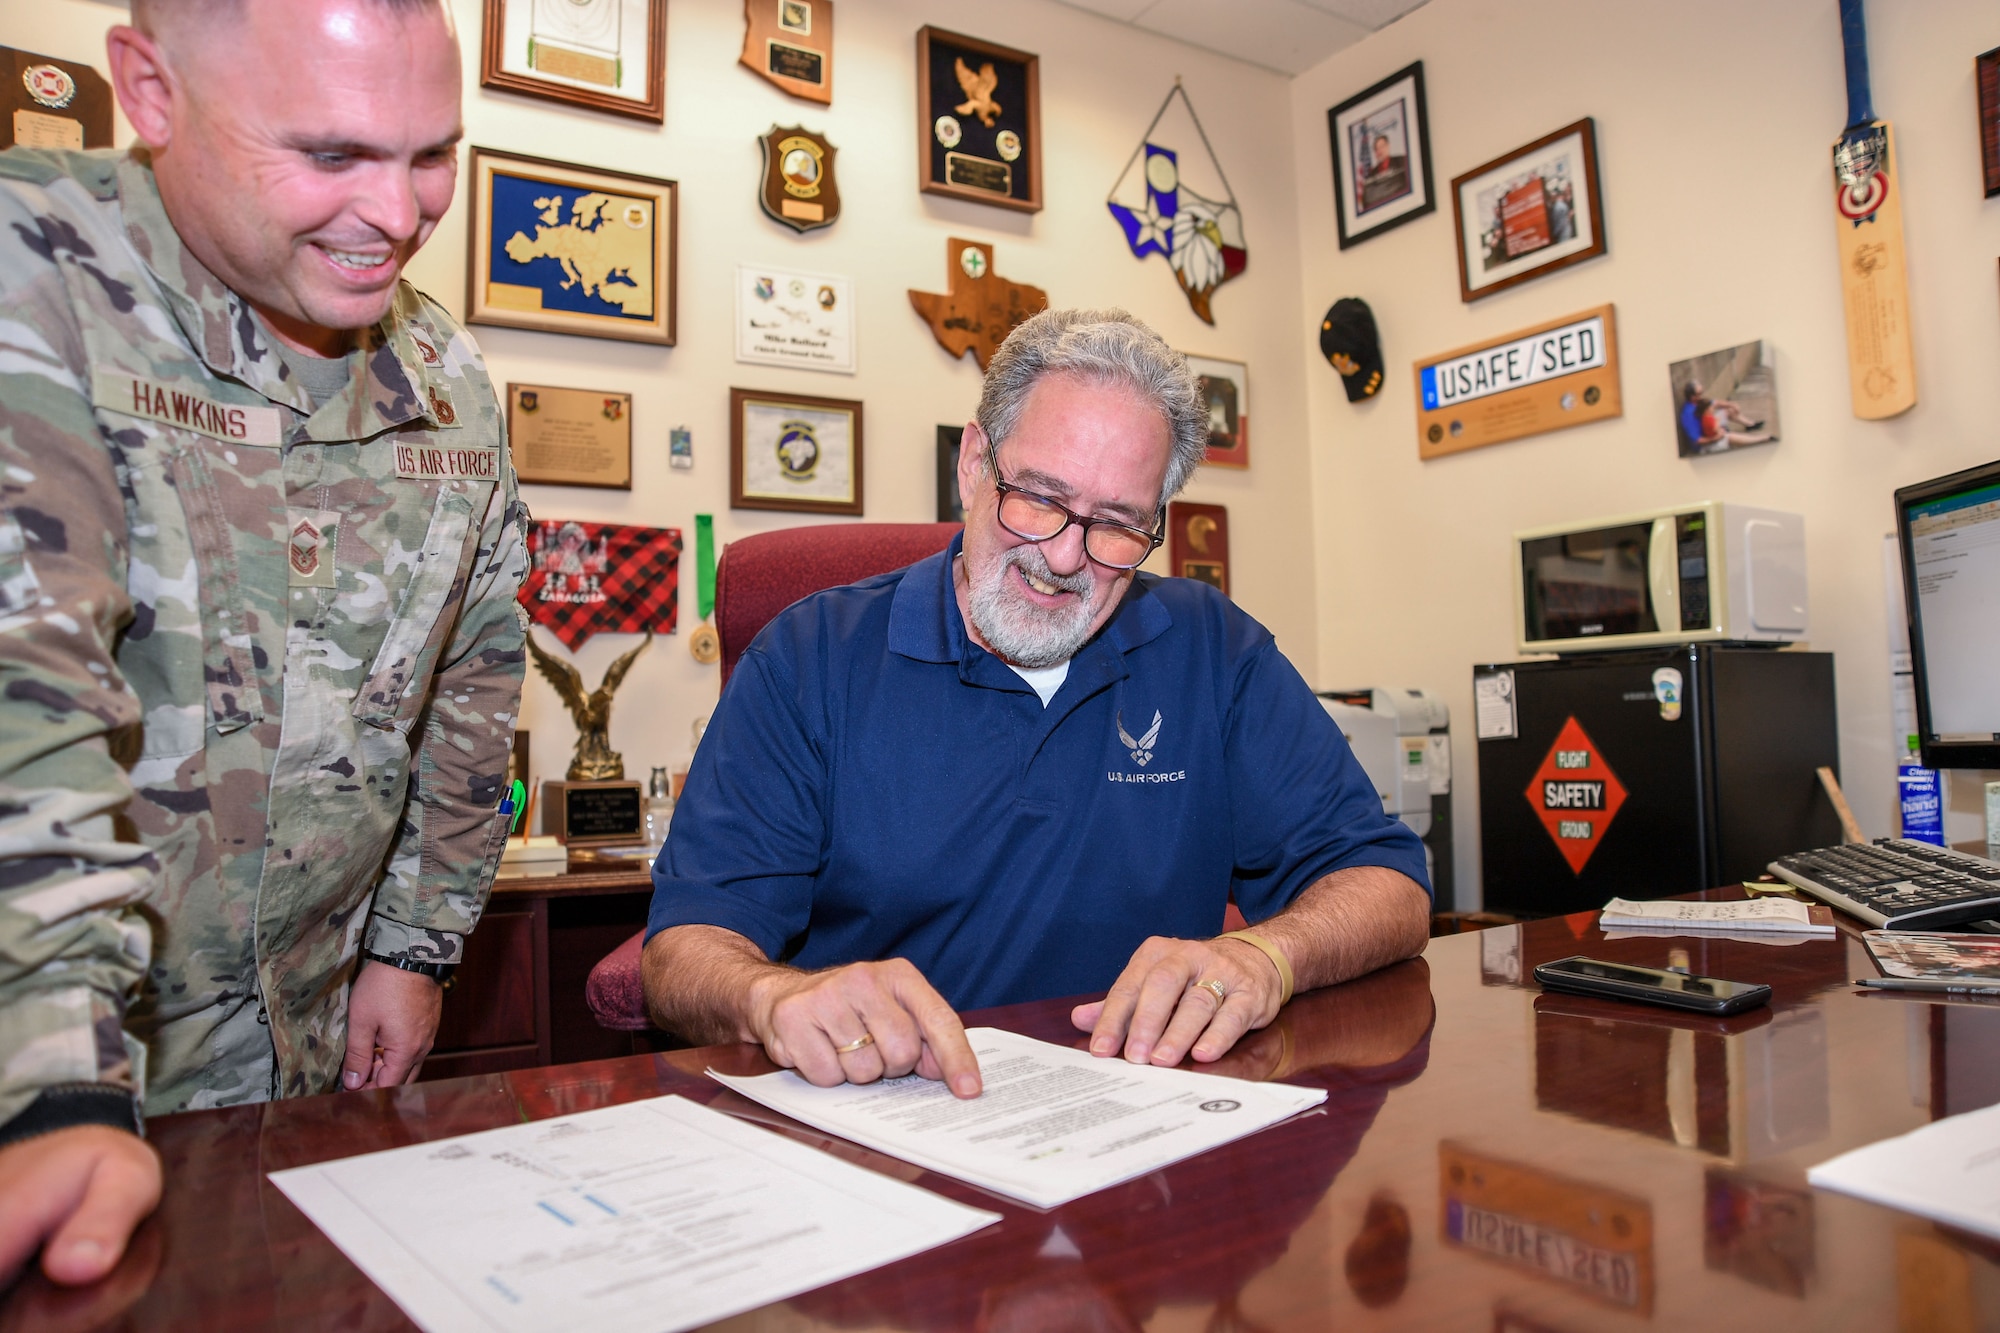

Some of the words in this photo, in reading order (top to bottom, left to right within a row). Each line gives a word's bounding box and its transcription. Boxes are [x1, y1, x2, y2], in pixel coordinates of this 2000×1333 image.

[1441, 329, 1595, 399] USAFE/SED
[133, 380, 246, 439] HAWKINS
[420, 449, 446, 474] AIR
[448, 450, 495, 476] FORCE
[1558, 752, 1588, 768] FLIGHT
[1125, 773, 1145, 783] AIR
[1146, 770, 1186, 783] FORCE
[1545, 782, 1602, 807] SAFETY
[1903, 796, 1938, 813] hand
[1560, 821, 1590, 839] GROUND
